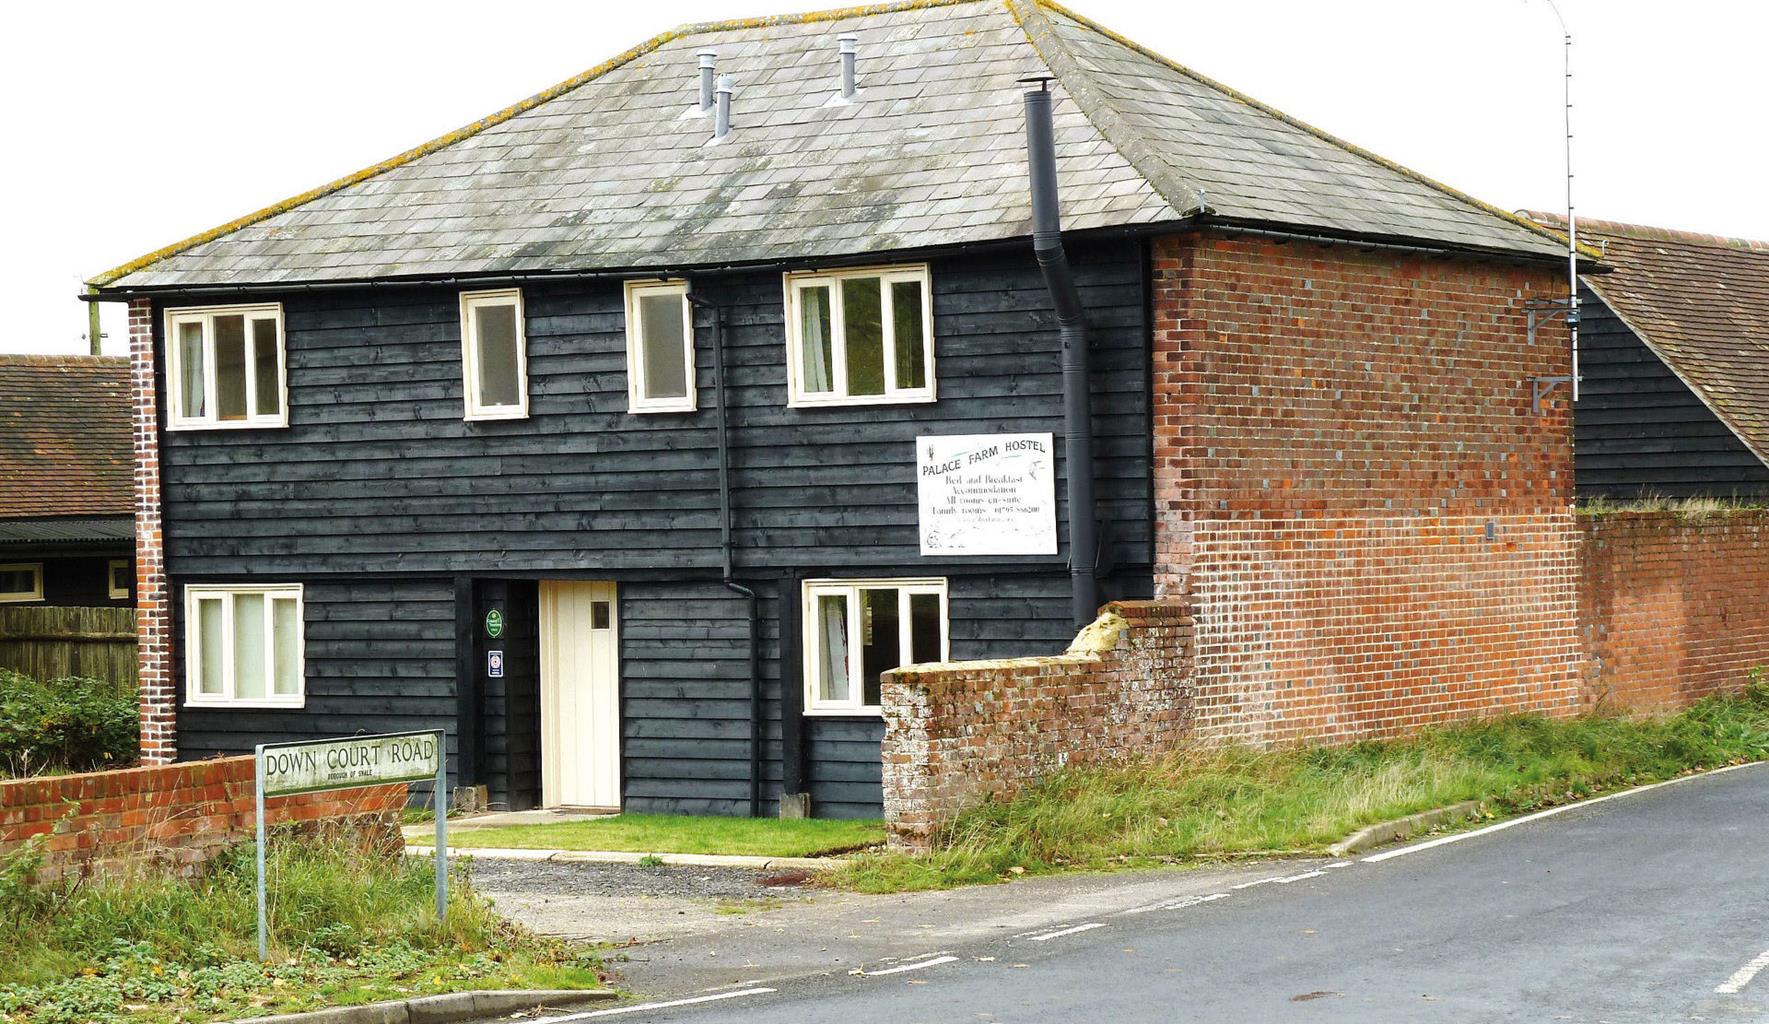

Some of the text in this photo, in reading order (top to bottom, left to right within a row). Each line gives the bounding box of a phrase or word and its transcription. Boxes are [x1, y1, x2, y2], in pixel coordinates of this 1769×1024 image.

[922, 439, 1046, 476] PALACE FARM HOSTEL
[945, 474, 1023, 485] Bed and Breakfast
[266, 740, 434, 776] DOWN COURT ROAD
[327, 772, 348, 780] BOROUGH
